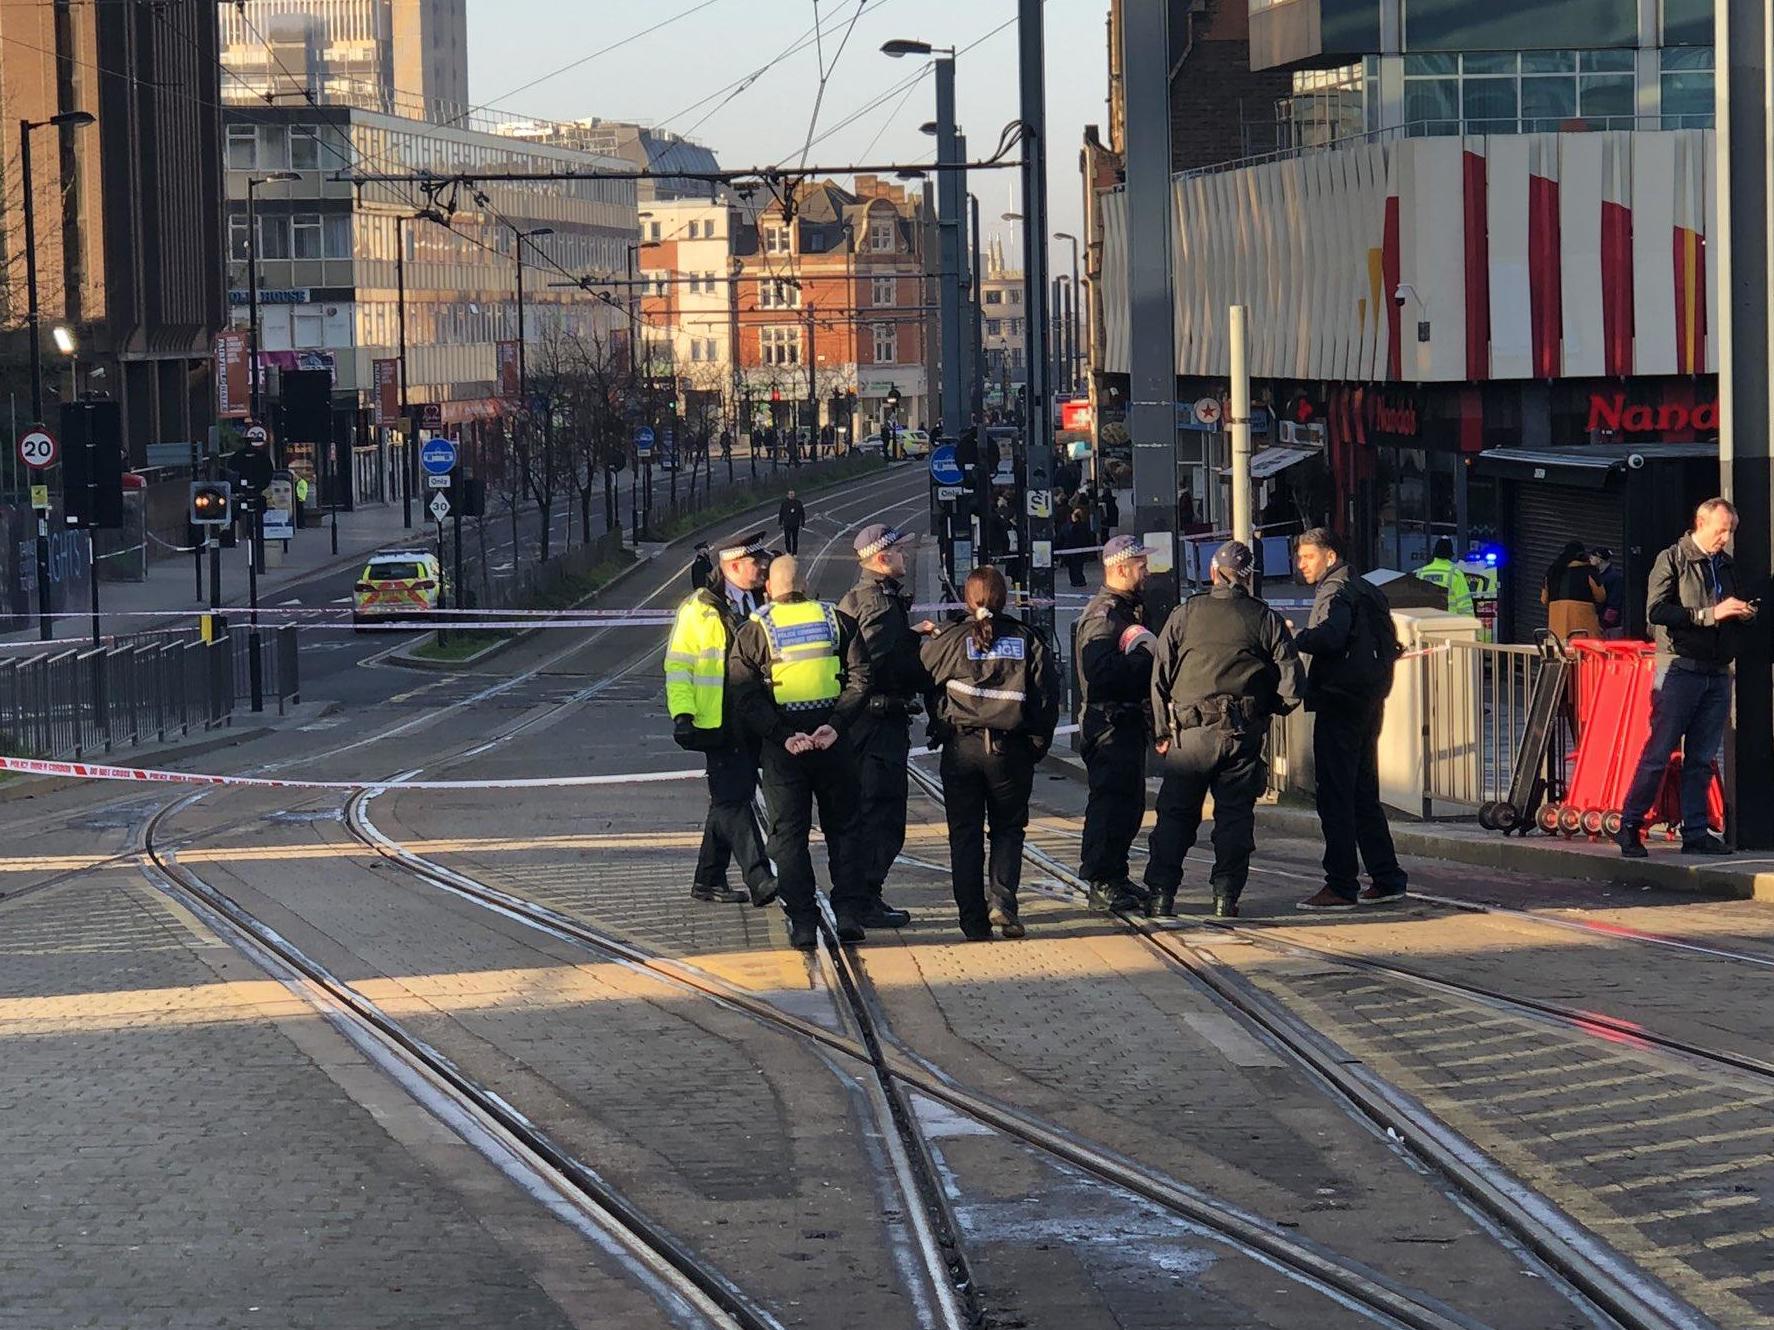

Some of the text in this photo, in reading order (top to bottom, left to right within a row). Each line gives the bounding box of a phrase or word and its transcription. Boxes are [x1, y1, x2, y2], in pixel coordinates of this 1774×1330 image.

[260, 291, 305, 303] HOUSE
[1586, 394, 1720, 432] Nand
[25, 441, 51, 457] 20
[431, 477, 448, 485] Only
[433, 502, 447, 511] 30
